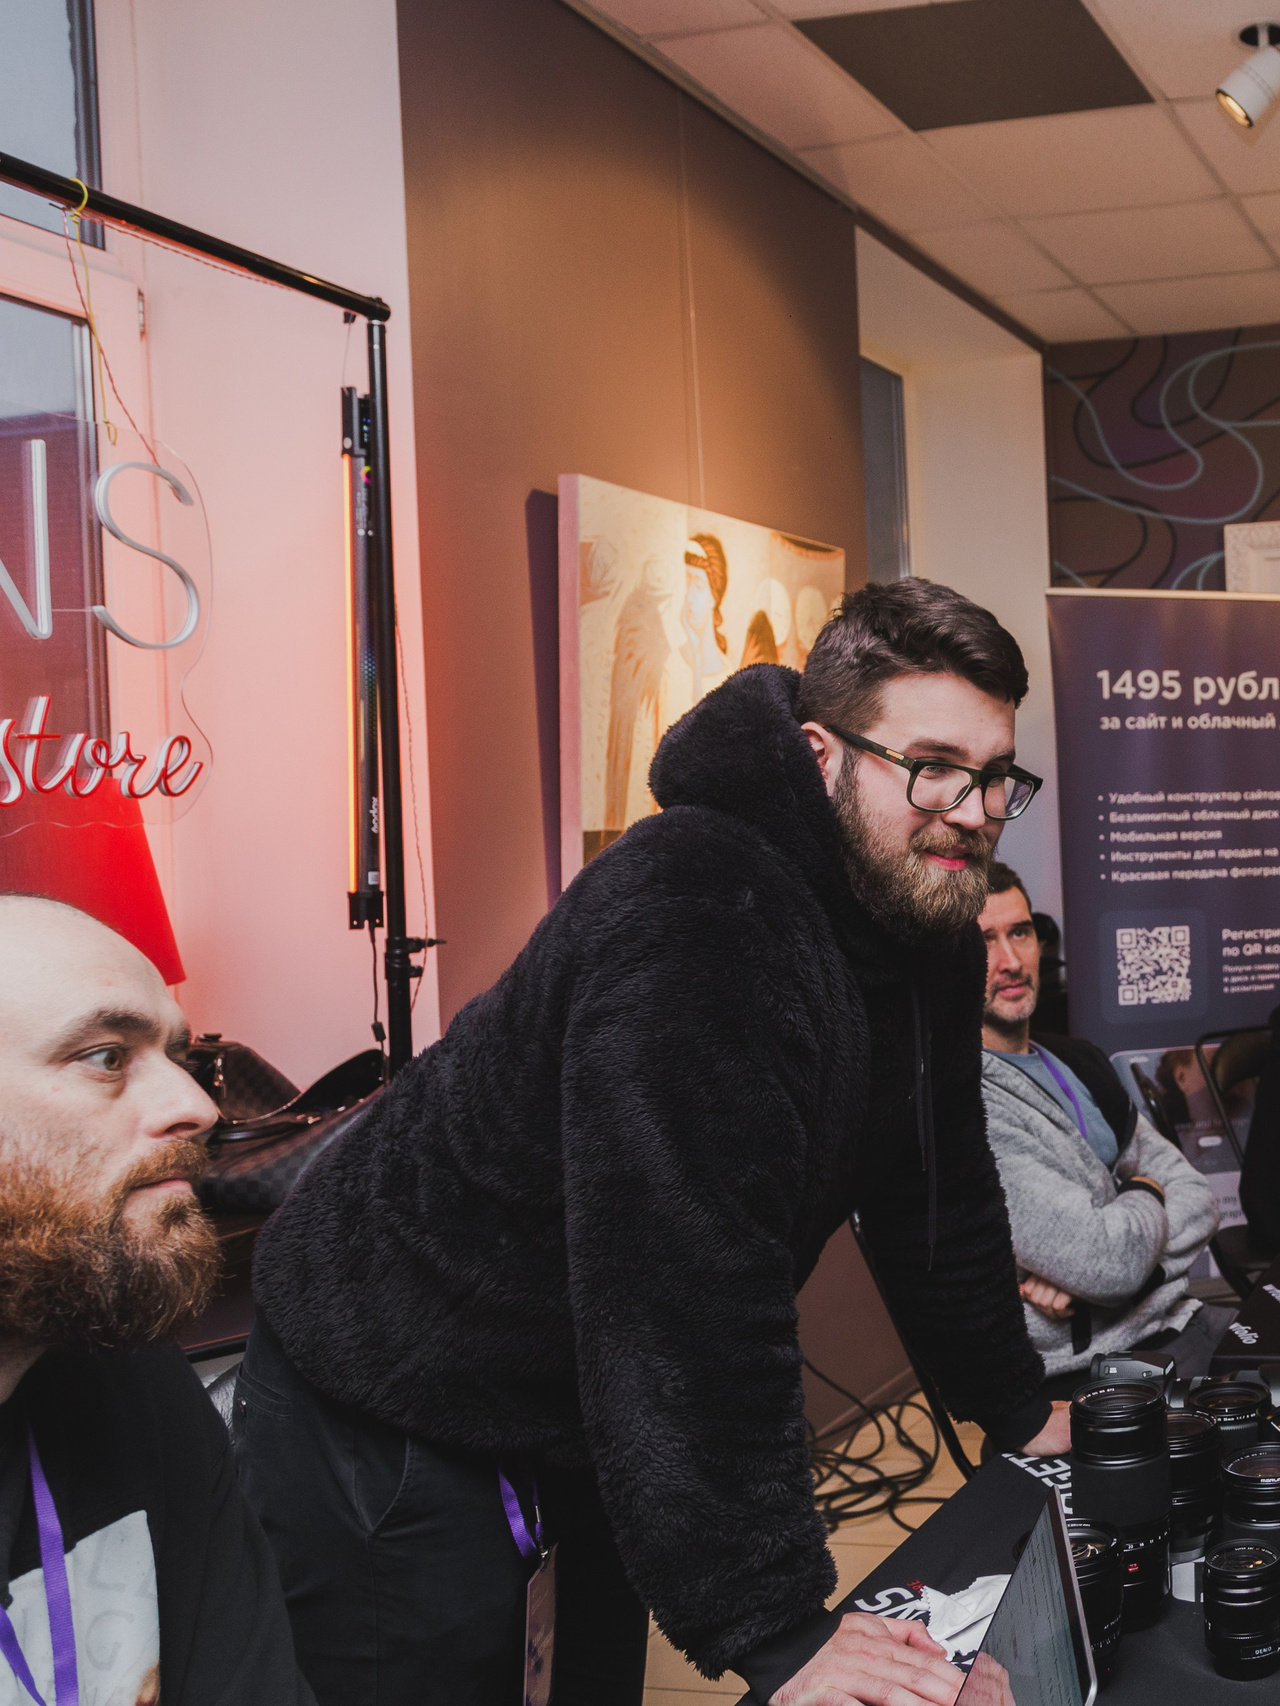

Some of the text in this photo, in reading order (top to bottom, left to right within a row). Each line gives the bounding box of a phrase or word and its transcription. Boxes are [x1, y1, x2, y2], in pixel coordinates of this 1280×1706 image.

[1096, 668, 1182, 701] 1495
[1100, 715, 1121, 730] за
[1125, 712, 1168, 730] сайт
[1171, 715, 1184, 729] и
[1187, 711, 1277, 730] облачный
[1109, 791, 1166, 805] Удобный
[1167, 790, 1242, 804] конструктор
[1109, 808, 1280, 824] Безлимитный облачный диск
[1110, 829, 1223, 843] Мобильная версия
[1110, 850, 1192, 864] Инструменты
[1111, 869, 1170, 884] Красивая
[1171, 867, 1229, 882] передача
[1222, 946, 1241, 958] по
[1242, 943, 1263, 957] QR
[1228, 1321, 1260, 1345] wfolio
